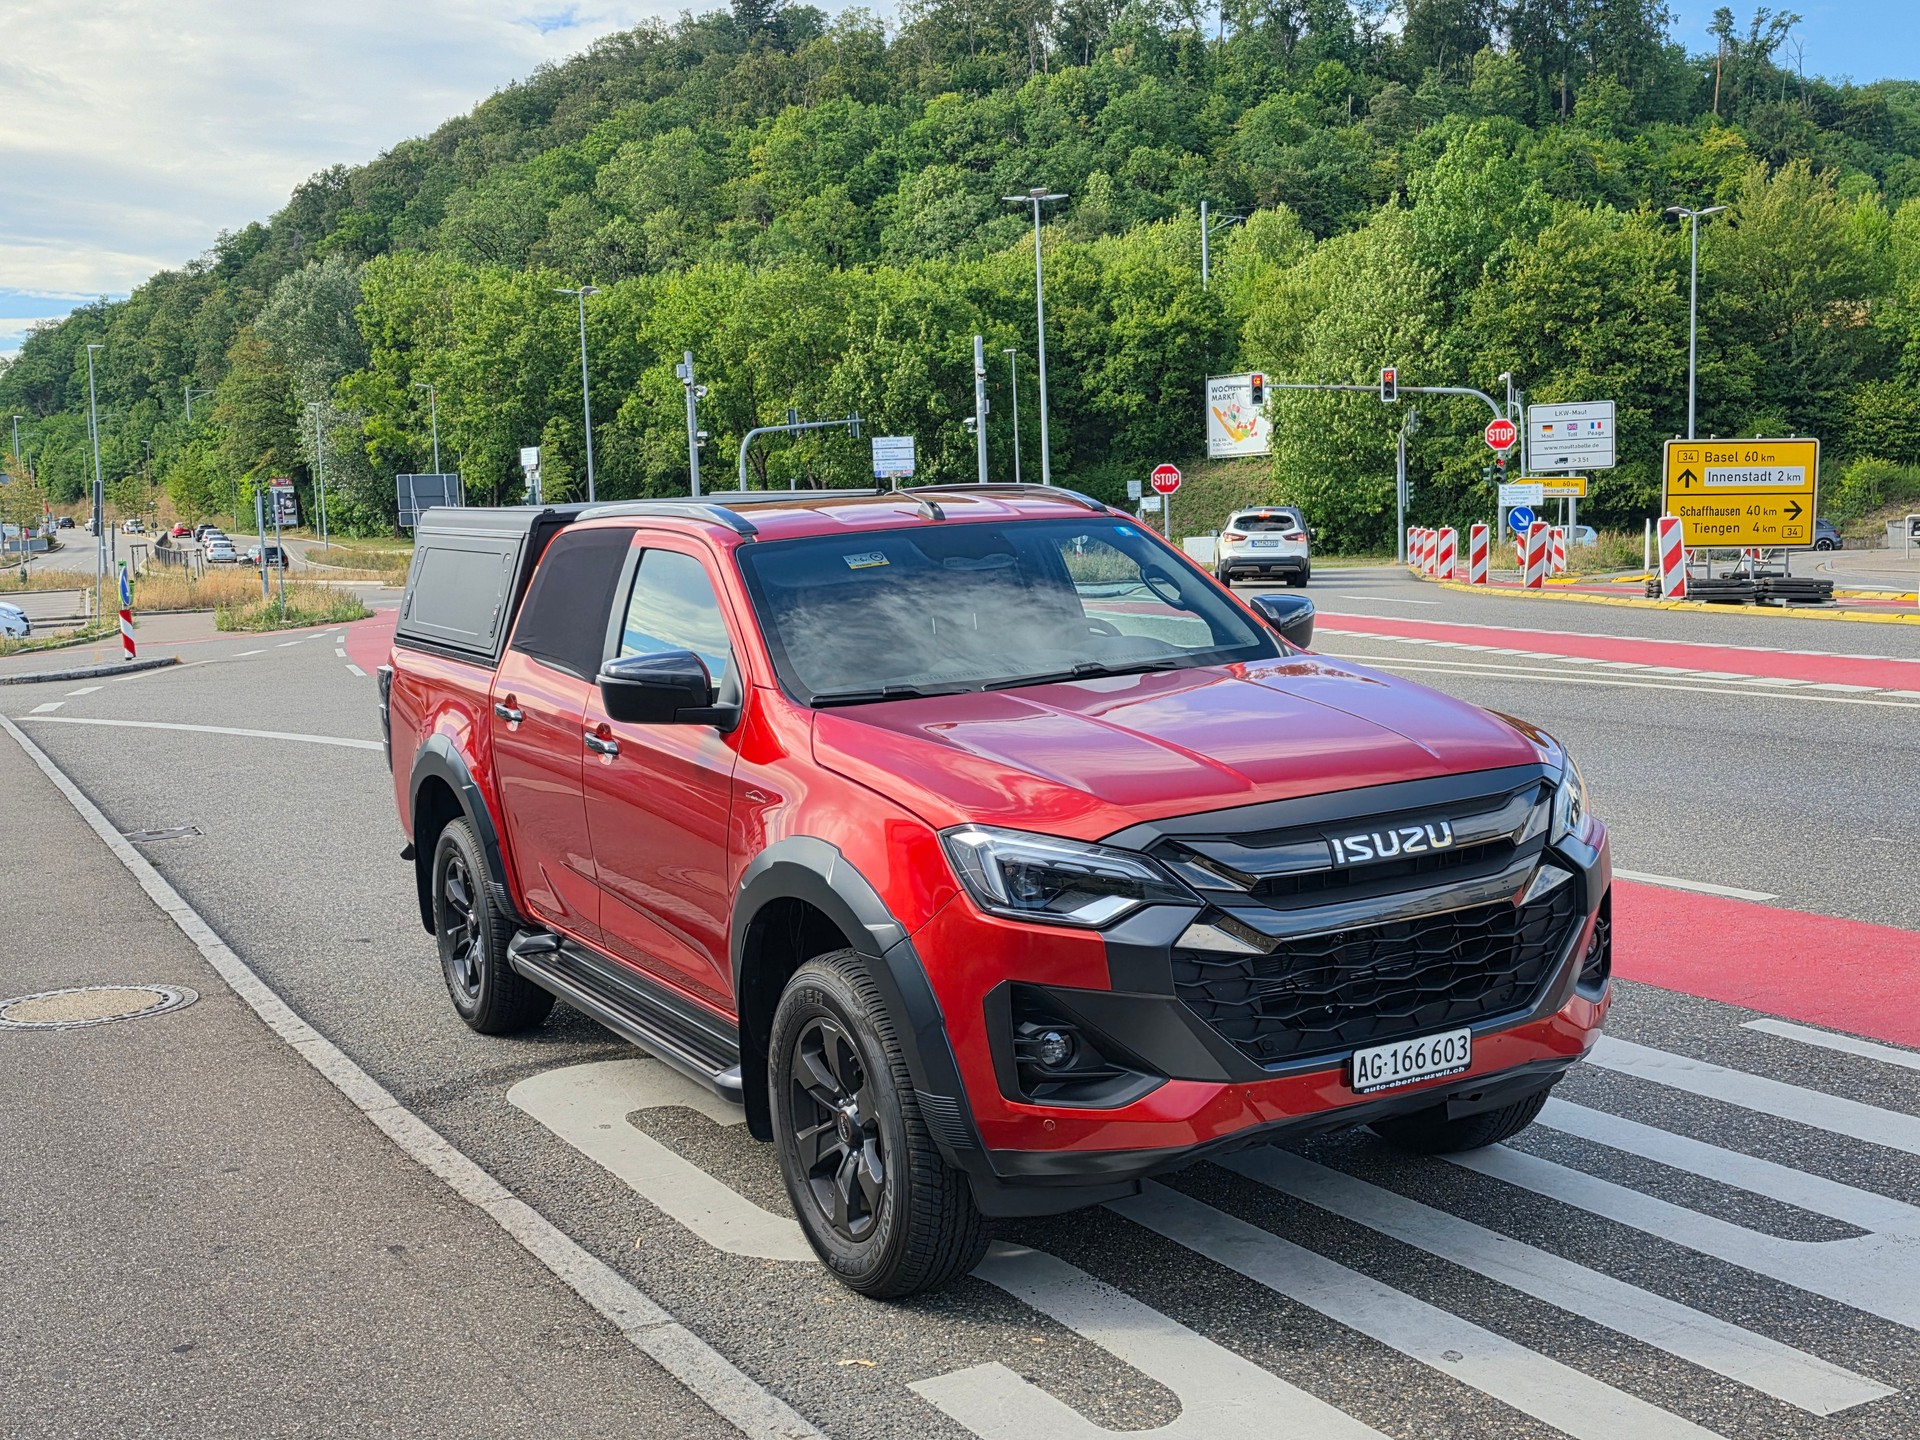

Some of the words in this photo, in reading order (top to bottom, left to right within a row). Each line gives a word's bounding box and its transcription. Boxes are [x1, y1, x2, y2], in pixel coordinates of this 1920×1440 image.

[1211, 393, 1236, 401] MARKT
[1488, 428, 1514, 441] STOP
[1682, 453, 1694, 461] 34
[1704, 451, 1739, 463] Basel
[1744, 451, 1759, 462] 60
[1761, 453, 1775, 462] km
[1154, 473, 1178, 486] STOP
[1708, 470, 1772, 482] Innenstadt
[1777, 470, 1784, 481] 2
[1787, 472, 1801, 481] km
[1680, 505, 1741, 517] Schaffhausen
[1746, 505, 1761, 516] 40
[1763, 507, 1777, 516] km
[1692, 522, 1740, 536] Tiengen
[1752, 522, 1760, 533] 4
[1762, 524, 1776, 533] km
[1786, 528, 1798, 536] 34
[1331, 821, 1453, 864] ISUZU
